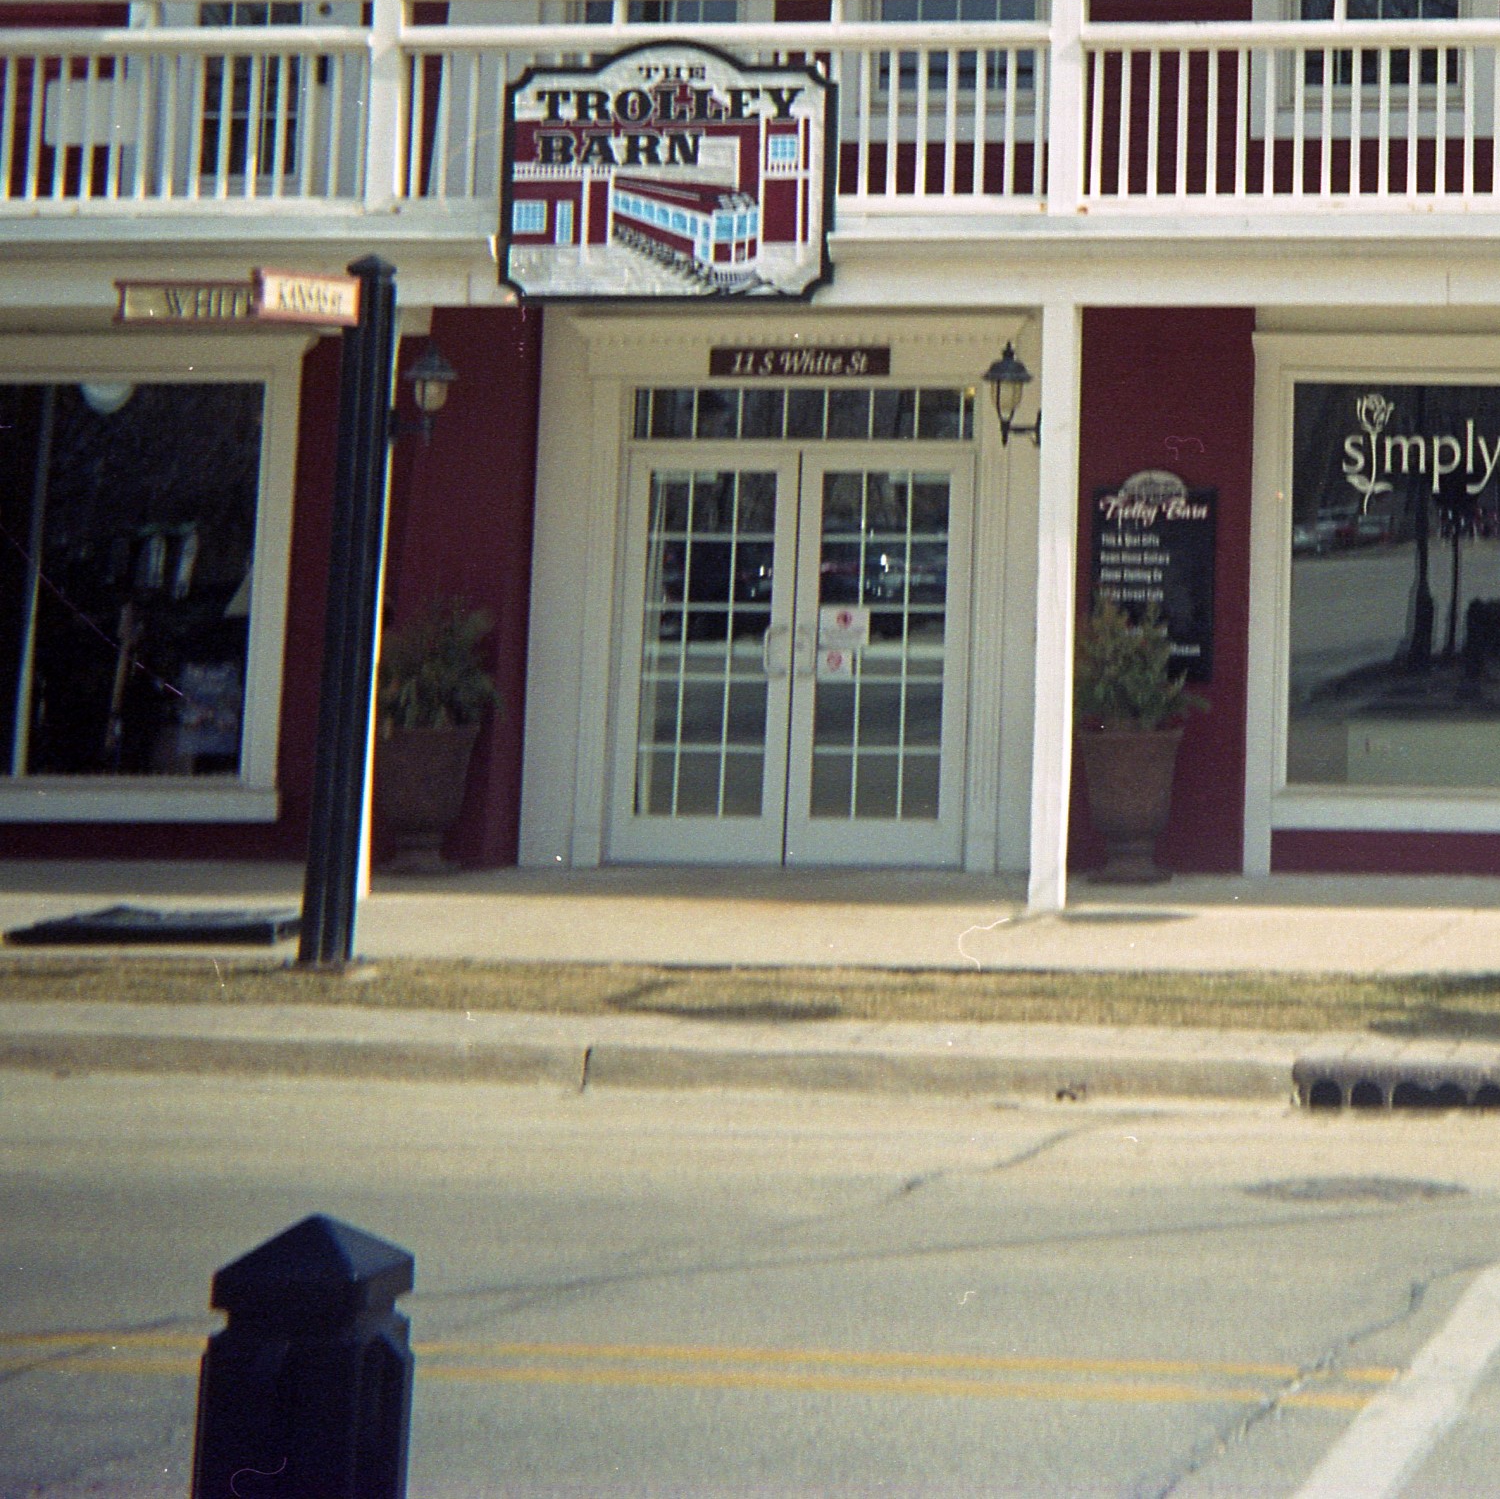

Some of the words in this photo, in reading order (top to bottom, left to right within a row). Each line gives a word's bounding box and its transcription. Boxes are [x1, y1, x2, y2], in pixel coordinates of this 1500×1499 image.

[639, 66, 706, 80] THE
[536, 87, 805, 122] TROLLEY
[536, 130, 704, 166] BARN
[162, 286, 252, 319] WHIT
[731, 351, 755, 375] 11
[758, 350, 775, 376] S
[780, 349, 843, 375] White
[845, 350, 869, 376] St
[1099, 495, 1160, 528] Trolley
[1163, 498, 1209, 520] Barn
